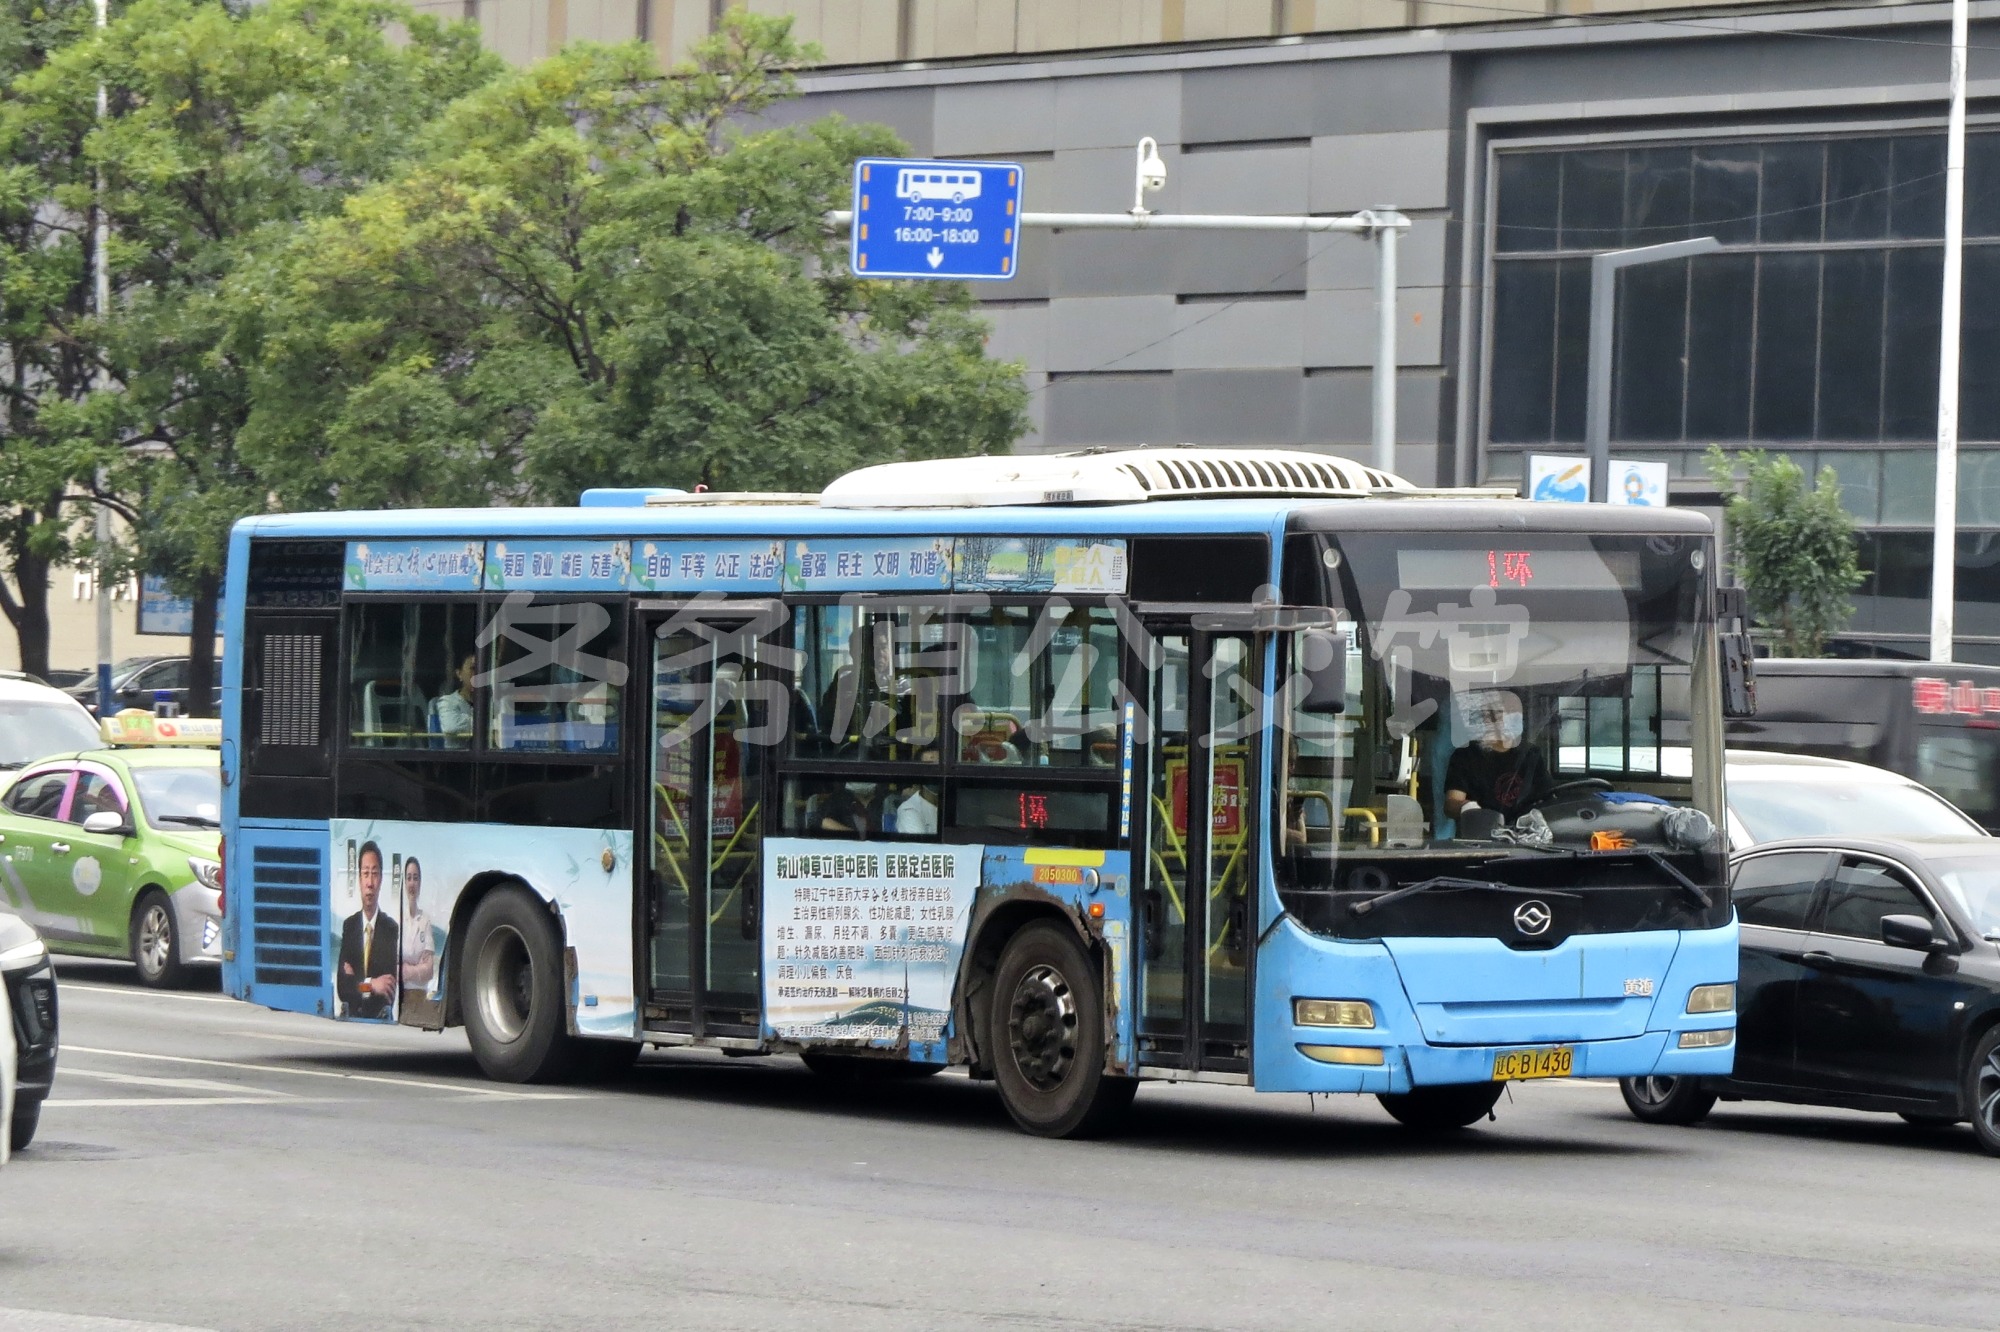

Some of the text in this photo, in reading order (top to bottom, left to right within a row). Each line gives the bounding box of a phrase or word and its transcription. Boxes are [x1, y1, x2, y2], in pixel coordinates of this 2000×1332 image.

[903, 206, 973, 223] 7:00-9:00
[893, 227, 980, 244] 16:00-18:00
[364, 547, 472, 576] 社会主义核心价值观
[503, 552, 613, 579] 爱国 敬业 诚信 友善
[647, 553, 775, 579] 自由 平等 公正 法治
[801, 551, 937, 578] 富强 民主 文明 和谐
[886, 854, 954, 879] 医保定点医院
[1039, 868, 1078, 881] 2050300
[1623, 978, 1653, 996] 黄海
